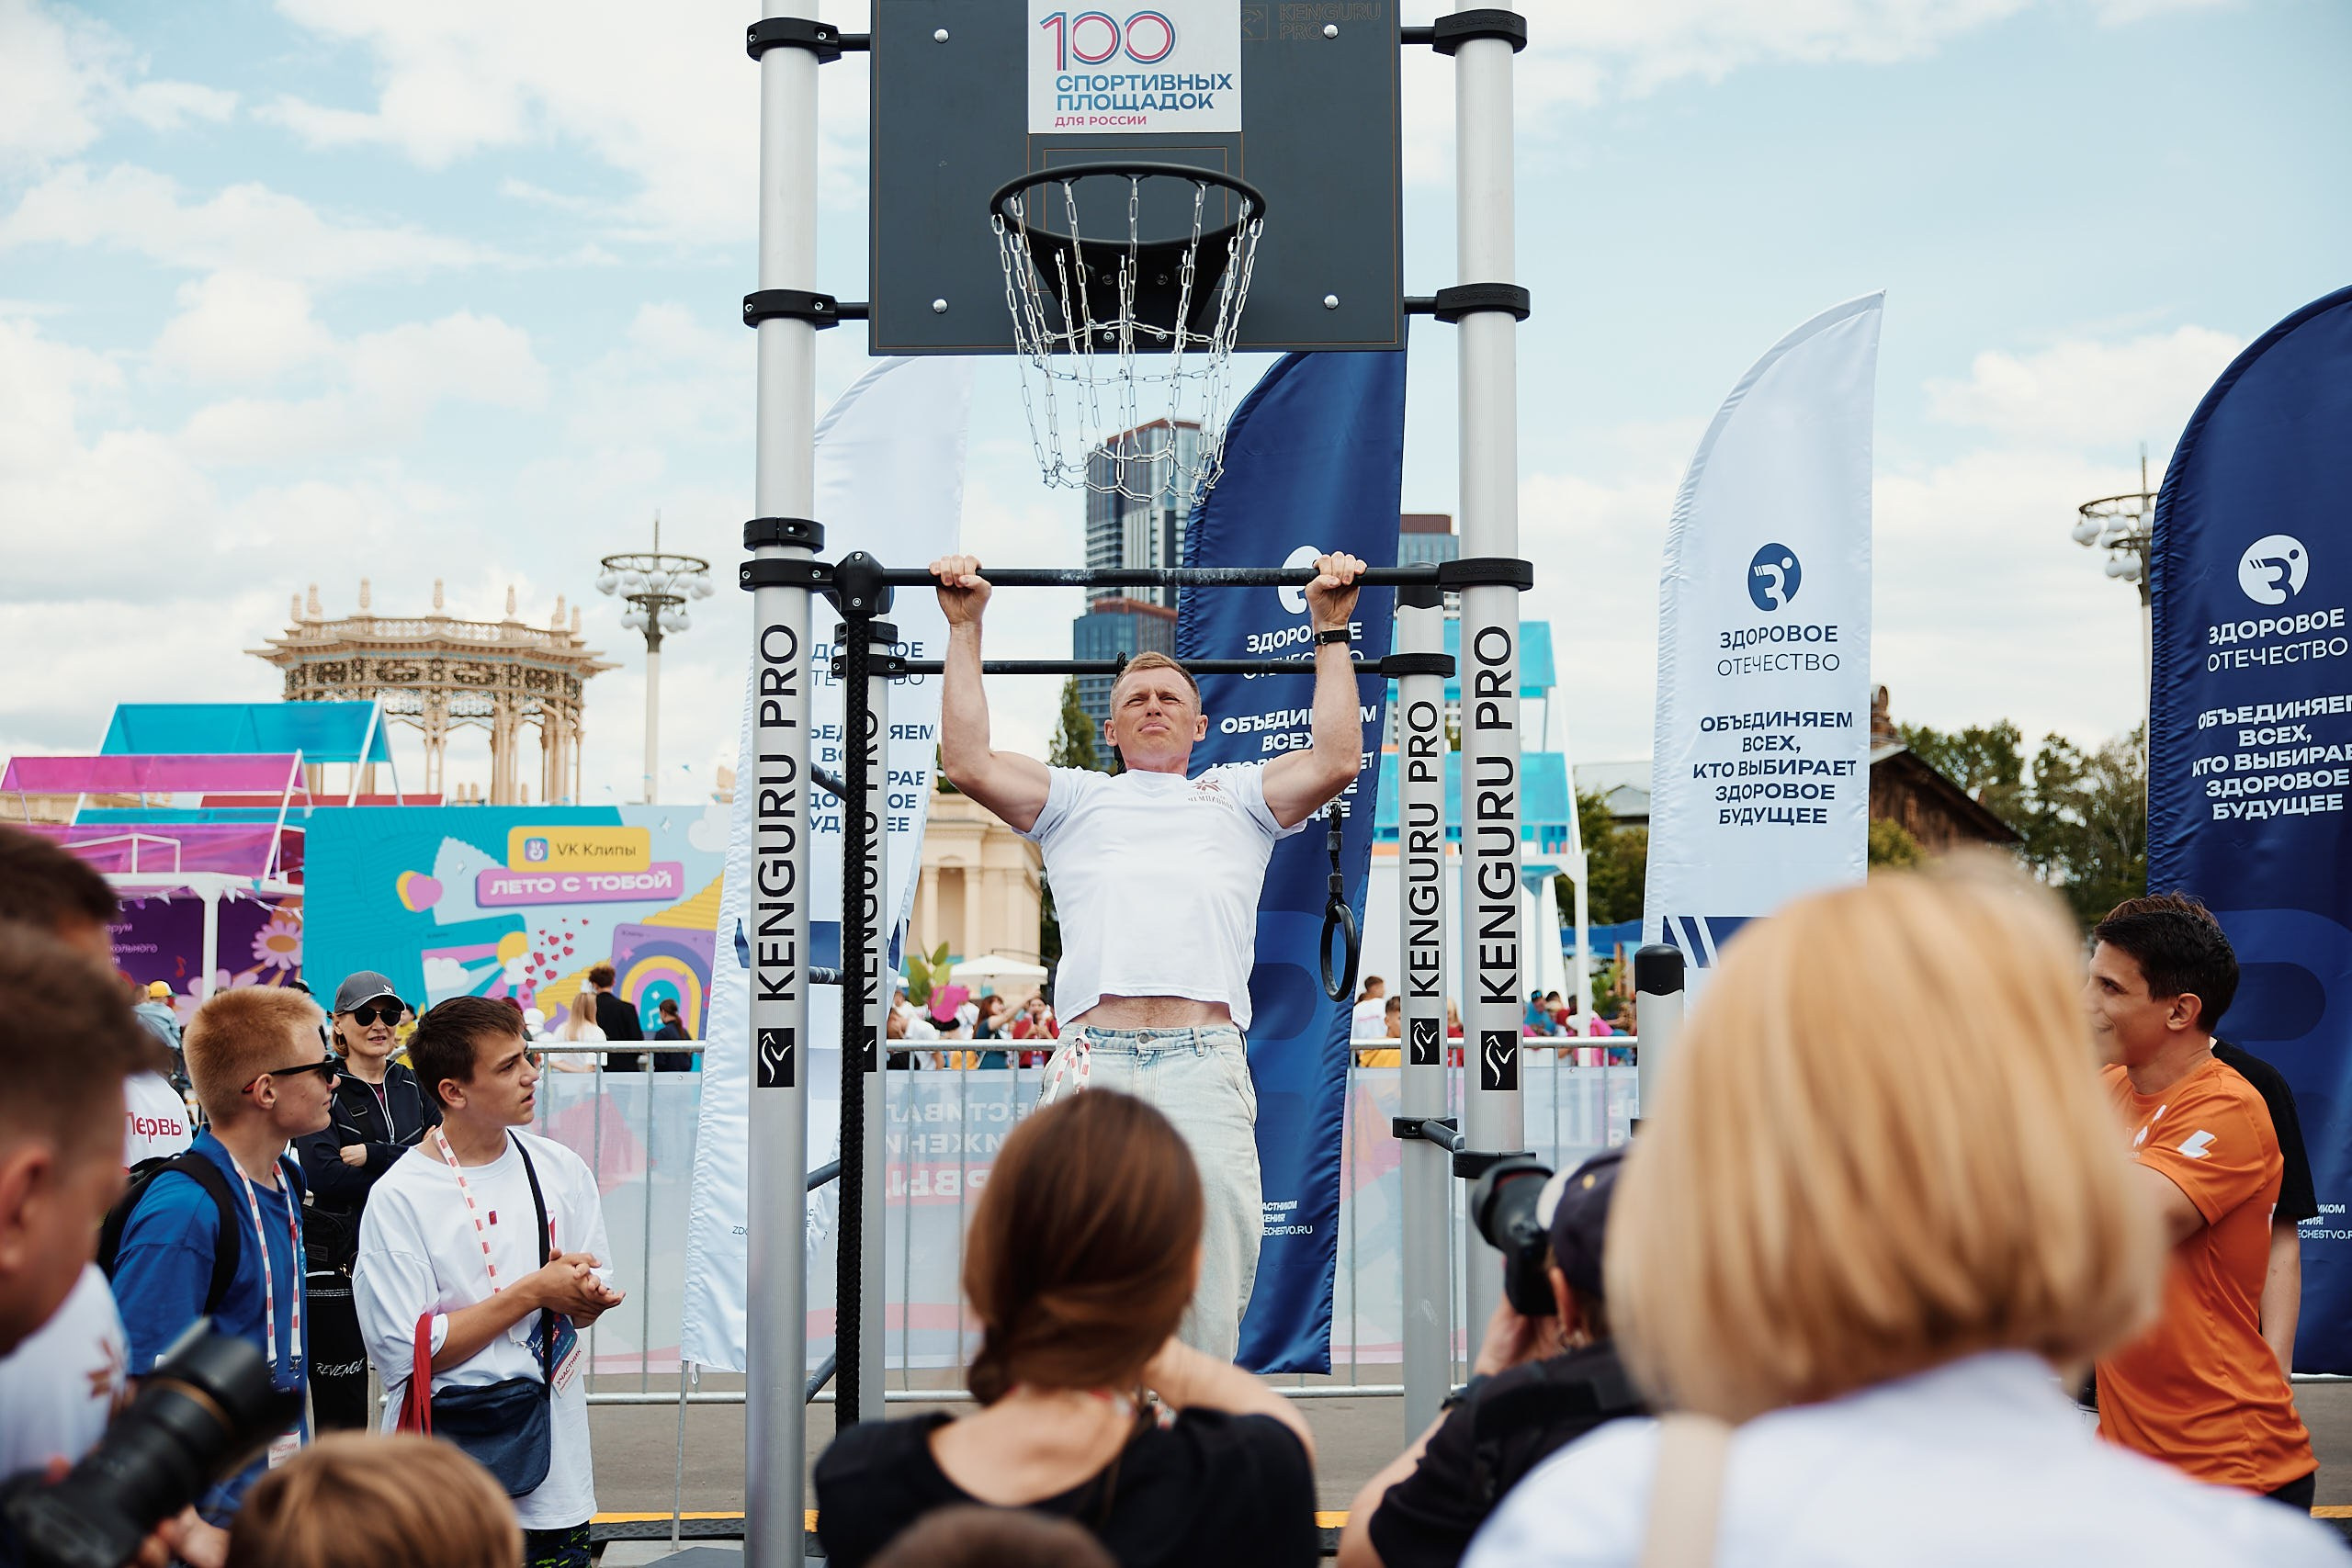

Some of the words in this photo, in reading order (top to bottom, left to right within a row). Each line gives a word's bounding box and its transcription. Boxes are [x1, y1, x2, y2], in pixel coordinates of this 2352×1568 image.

[1280, 3, 1382, 21] KENGURU
[1039, 10, 1176, 71] 100
[1280, 22, 1324, 40] PRO
[1056, 73, 1233, 92] СПОРТИВНЫХ
[1057, 93, 1215, 111] ПЛОЩАДОК
[1055, 116, 1085, 128] ДЛЯ
[1089, 116, 1148, 126] РОССИИ
[1246, 621, 1363, 655] ЗДОРОЕ
[1720, 625, 1838, 651] ЗДОРОВОЕ
[2208, 607, 2345, 646] ЗДОРОВОЕ
[1717, 653, 1840, 676] ОТЕЧЕСТВО
[2207, 637, 2348, 672] ОТЕЧЕСТВО
[759, 624, 798, 728] PRO
[1473, 626, 1513, 730] PRO
[1220, 705, 1377, 734] ОБЪЕДИМ
[1701, 711, 1852, 732] ОБЪЕДИНЯЕМ
[1407, 700, 1439, 783] PRO
[1742, 735, 1802, 754] ВСЕХ,
[2238, 724, 2312, 747] ВСЕХ,
[1693, 761, 1735, 779] КТО
[1737, 759, 1856, 777] ВЫБИРАЕТ
[2191, 755, 2229, 777] КТО
[2234, 743, 2352, 772] ВЫБИРАЕ
[1714, 783, 1836, 804] ЗДОРОВОЕ
[2205, 768, 2349, 799] ЗДОРОВОЕ
[1719, 807, 1827, 826] БУДУЩЕЕ
[2212, 793, 2344, 820] БУДУЩЕЕ
[557, 842, 578, 857] VK
[583, 842, 637, 857] Клипы
[490, 876, 557, 896] ЛЕТО
[561, 875, 581, 893] С
[587, 870, 673, 892] ТОБОЙ
[758, 754, 797, 1001] KENGURU
[1476, 756, 1518, 1004] KENGURU
[1408, 803, 1440, 998] KENGURU
[1262, 1224, 1313, 1236] ECHESTVO.RU
[556, 1348, 582, 1386] УЧАСТНИК
